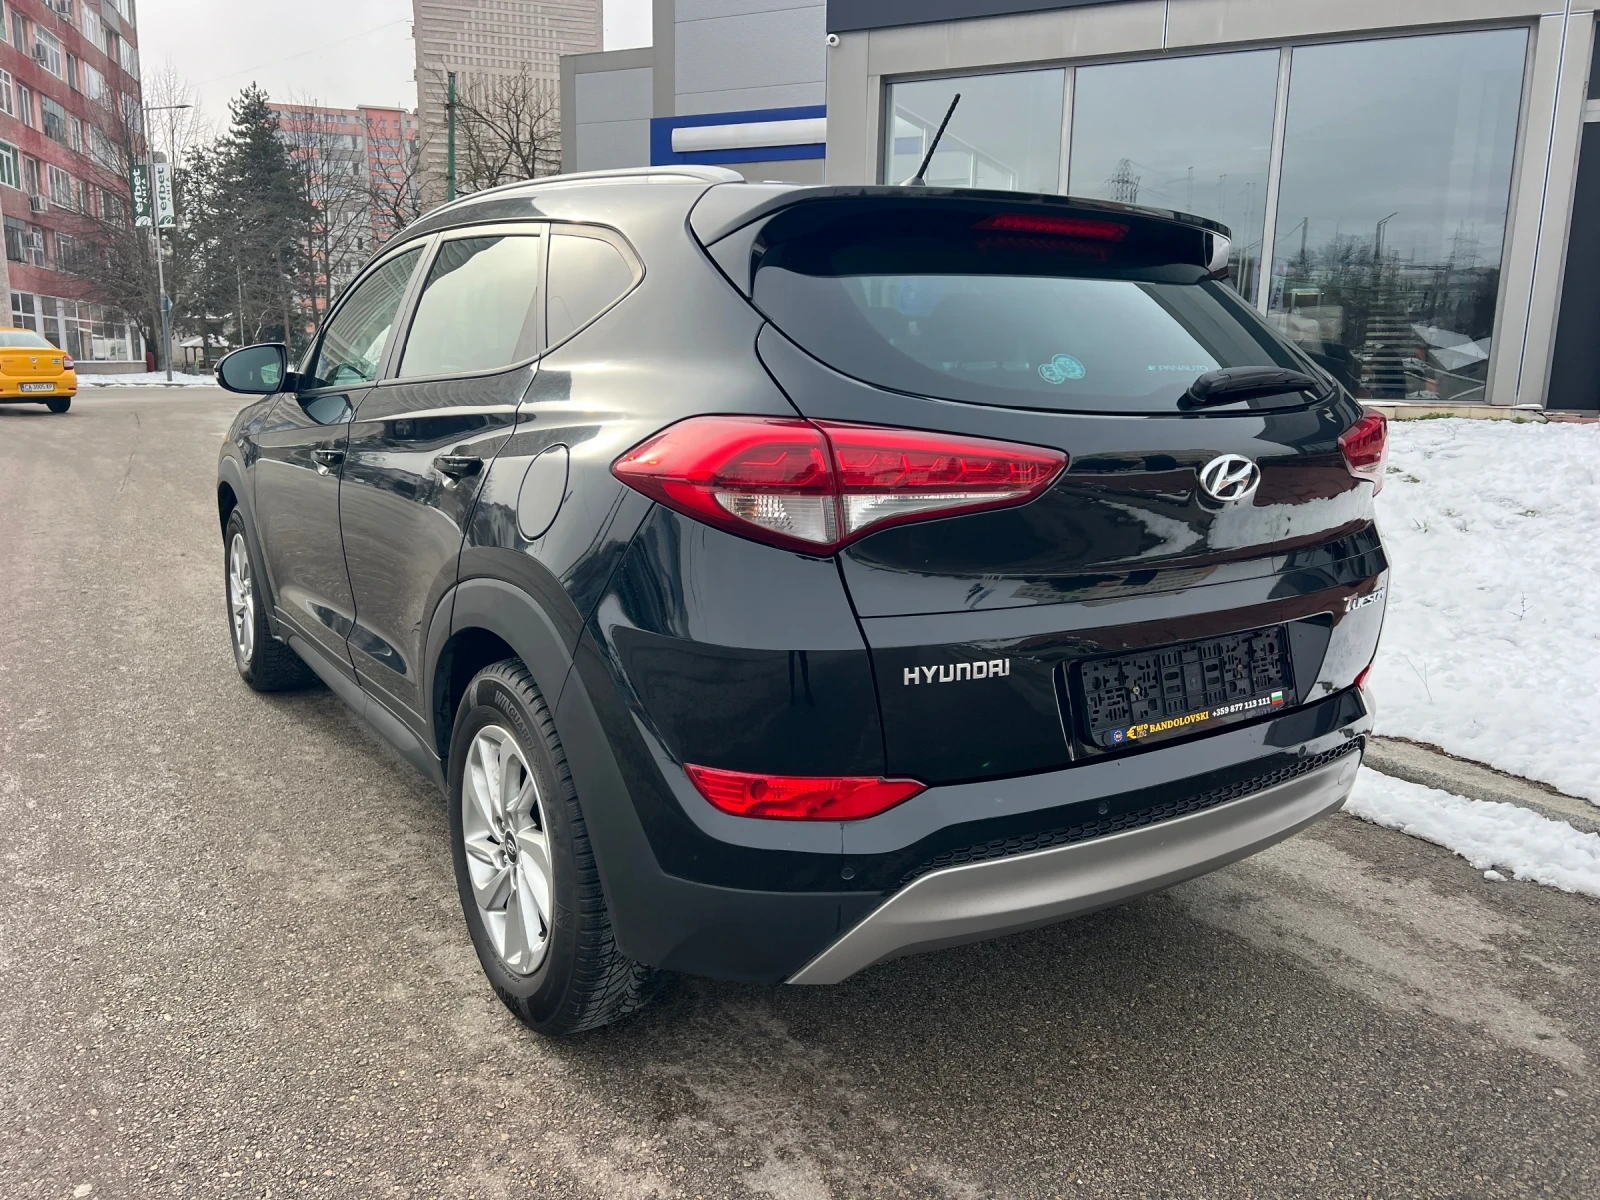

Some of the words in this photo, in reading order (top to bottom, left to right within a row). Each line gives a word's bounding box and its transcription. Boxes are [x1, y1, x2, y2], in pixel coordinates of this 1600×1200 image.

[132, 168, 143, 213] efbet
[157, 167, 167, 210] efbet
[1158, 364, 1209, 372] PANAUTO
[903, 658, 1010, 686] HYUNDAI
[494, 690, 536, 750] WINGUARD
[1150, 711, 1209, 732] BANDOLOVSKI
[1212, 706, 1230, 718] +359
[1230, 702, 1243, 713] 877
[1244, 699, 1257, 710] 113
[1257, 696, 1271, 707] 111
